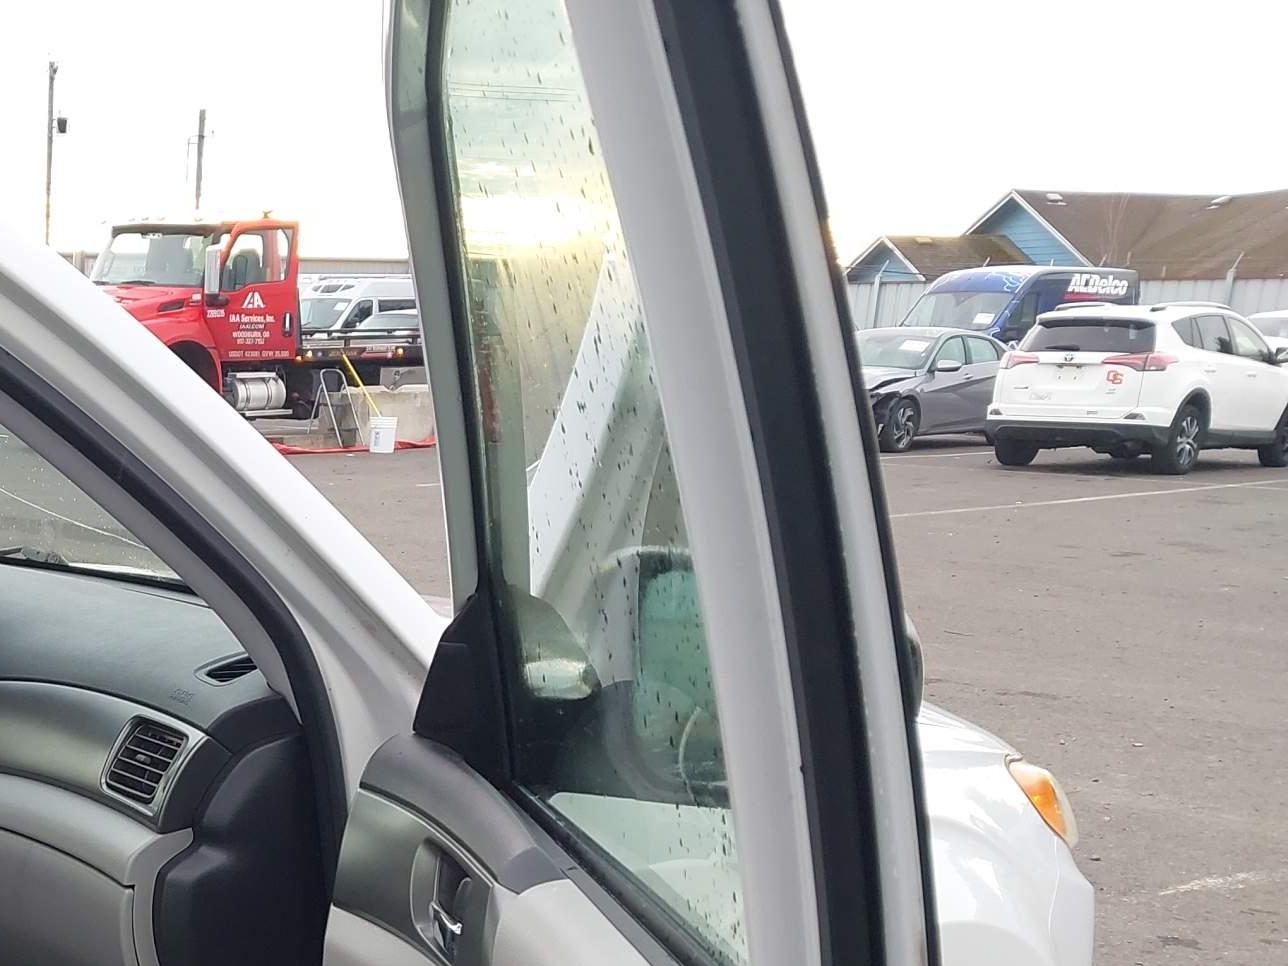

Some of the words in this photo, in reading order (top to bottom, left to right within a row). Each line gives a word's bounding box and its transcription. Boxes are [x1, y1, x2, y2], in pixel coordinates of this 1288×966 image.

[1068, 273, 1128, 295] ACDelco
[229, 314, 240, 322] IAA
[241, 314, 265, 323] Services,
[266, 314, 275, 322] Inc.
